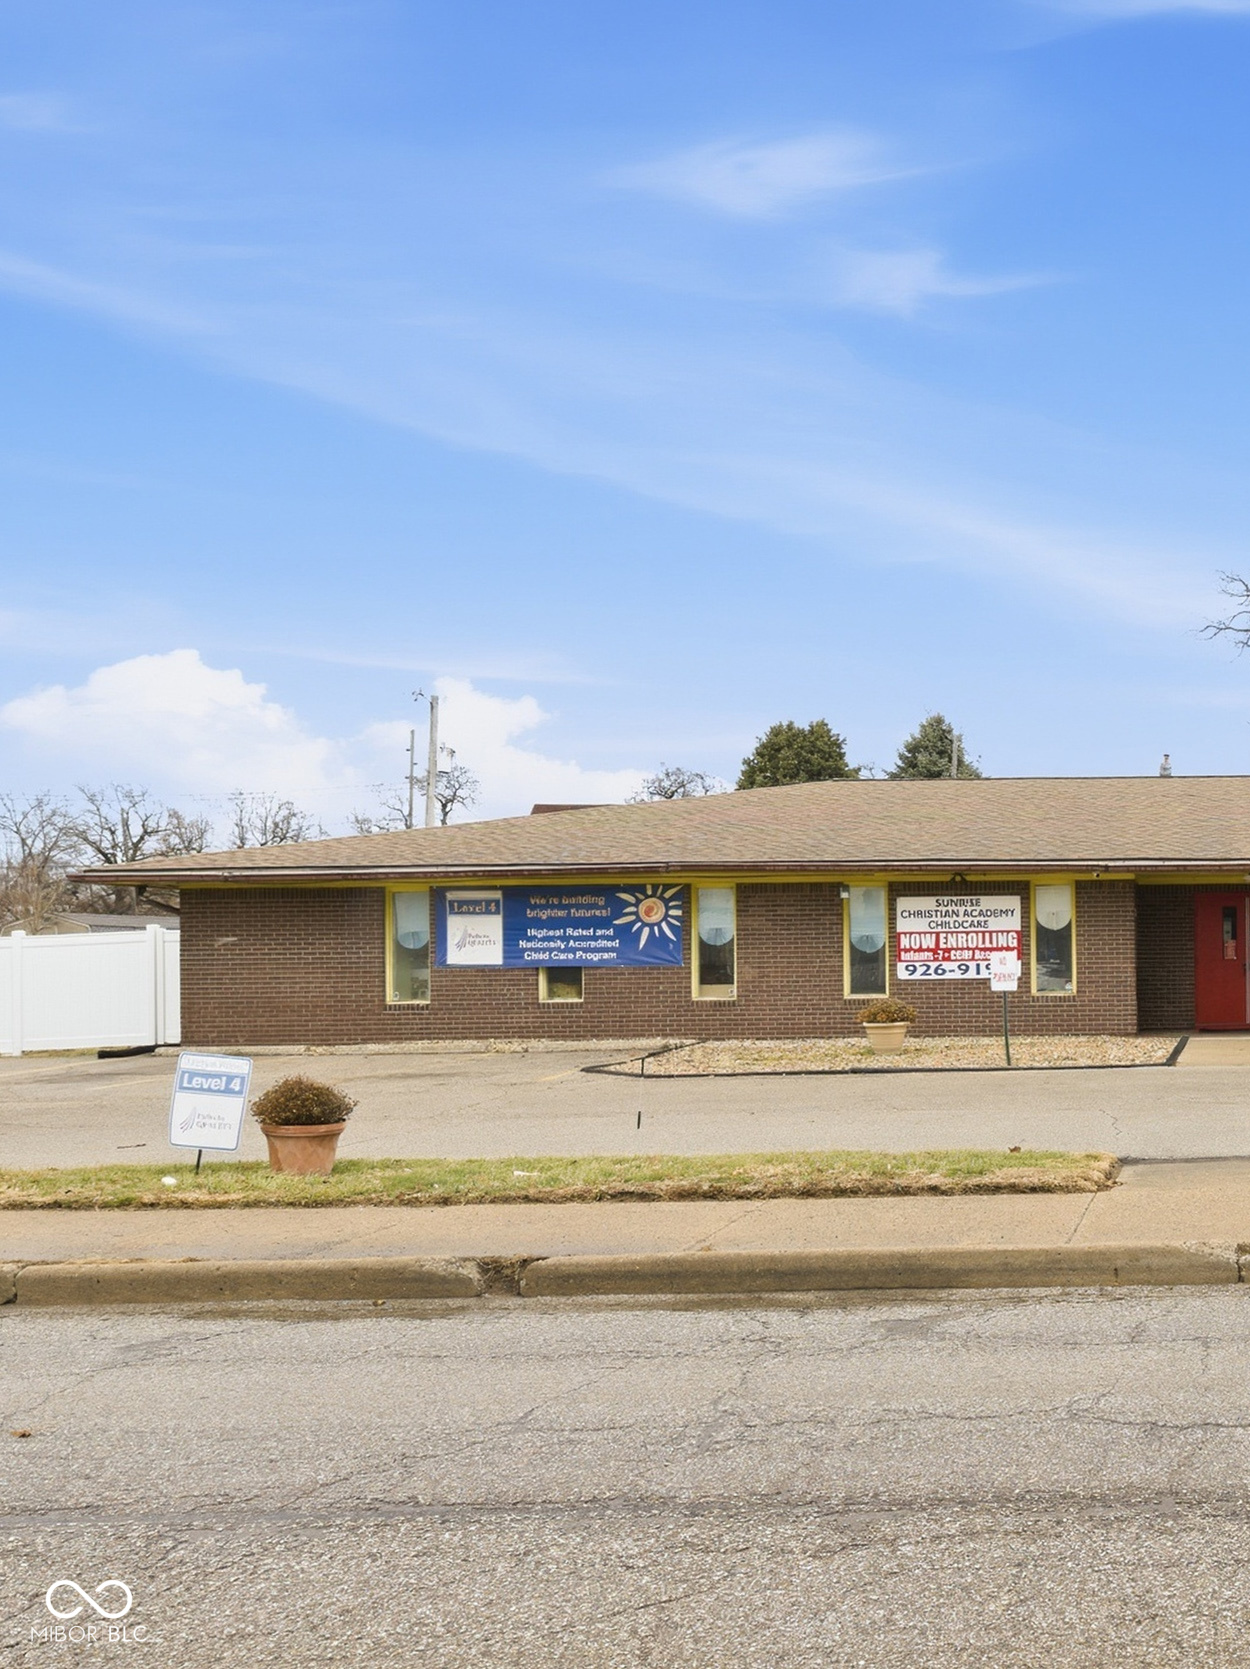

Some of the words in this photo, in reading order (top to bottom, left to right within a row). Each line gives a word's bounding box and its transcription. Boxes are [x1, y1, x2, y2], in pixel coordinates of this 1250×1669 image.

[562, 894, 605, 906] building
[935, 898, 981, 908] SUNRISE
[453, 901, 486, 912] Level
[488, 902, 496, 912] 4
[526, 907, 568, 919] brighter
[570, 907, 611, 917] futures!
[900, 909, 960, 919] CHRISTIAN
[963, 908, 1016, 918] ACADEMY
[928, 920, 989, 930] CHILDCARE
[527, 928, 564, 938] Highest
[566, 927, 594, 936] Rated
[595, 927, 614, 936] and
[900, 933, 936, 949] NOW
[939, 931, 1018, 949] ENROLLING
[524, 951, 549, 960] Child
[551, 951, 574, 960] Care
[576, 950, 617, 961] Program
[904, 963, 991, 977] 926-91
[182, 1072, 227, 1090] Level
[229, 1077, 241, 1092] 4
